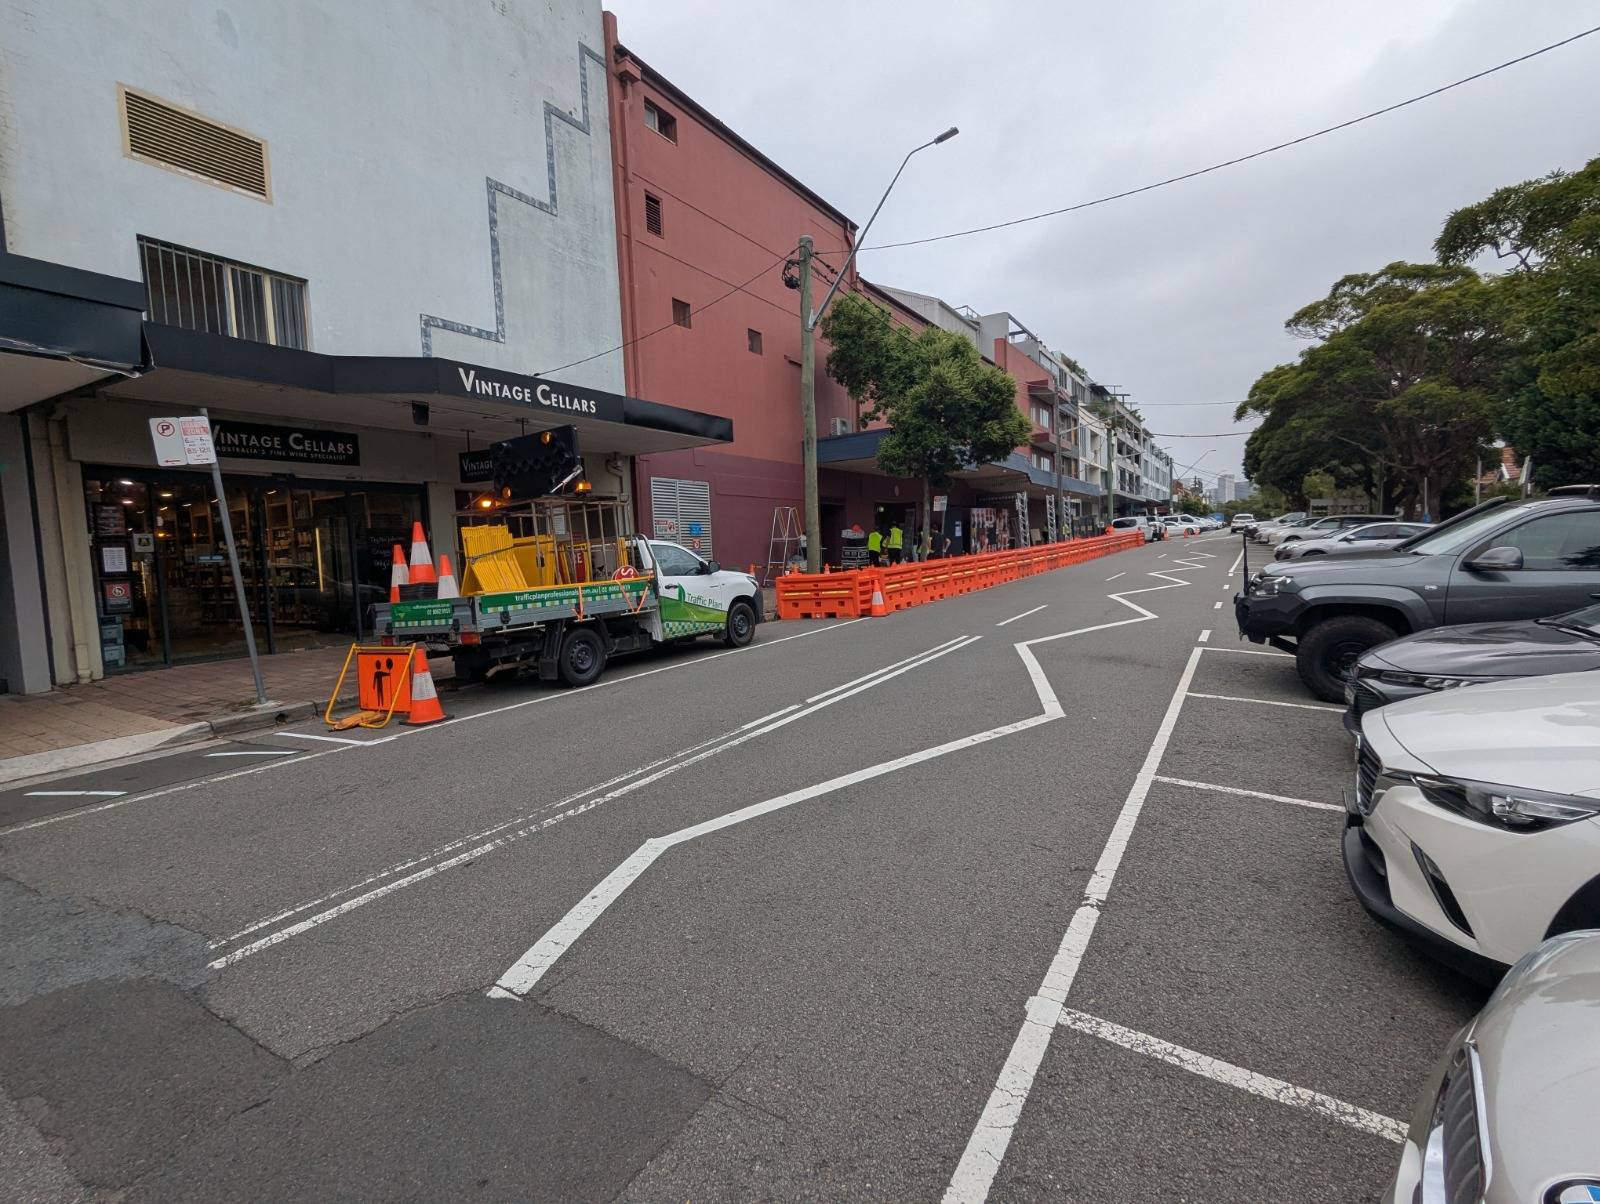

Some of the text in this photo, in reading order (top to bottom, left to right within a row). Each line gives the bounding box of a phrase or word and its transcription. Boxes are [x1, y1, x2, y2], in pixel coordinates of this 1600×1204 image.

[458, 367, 596, 413] VINTAGE CELLARS
[288, 433, 353, 455] CELLARS
[310, 453, 346, 461] SPECIALIST
[515, 587, 599, 601] trafficplanprofessionalscom.au
[687, 592, 723, 609] Traffic Plan
